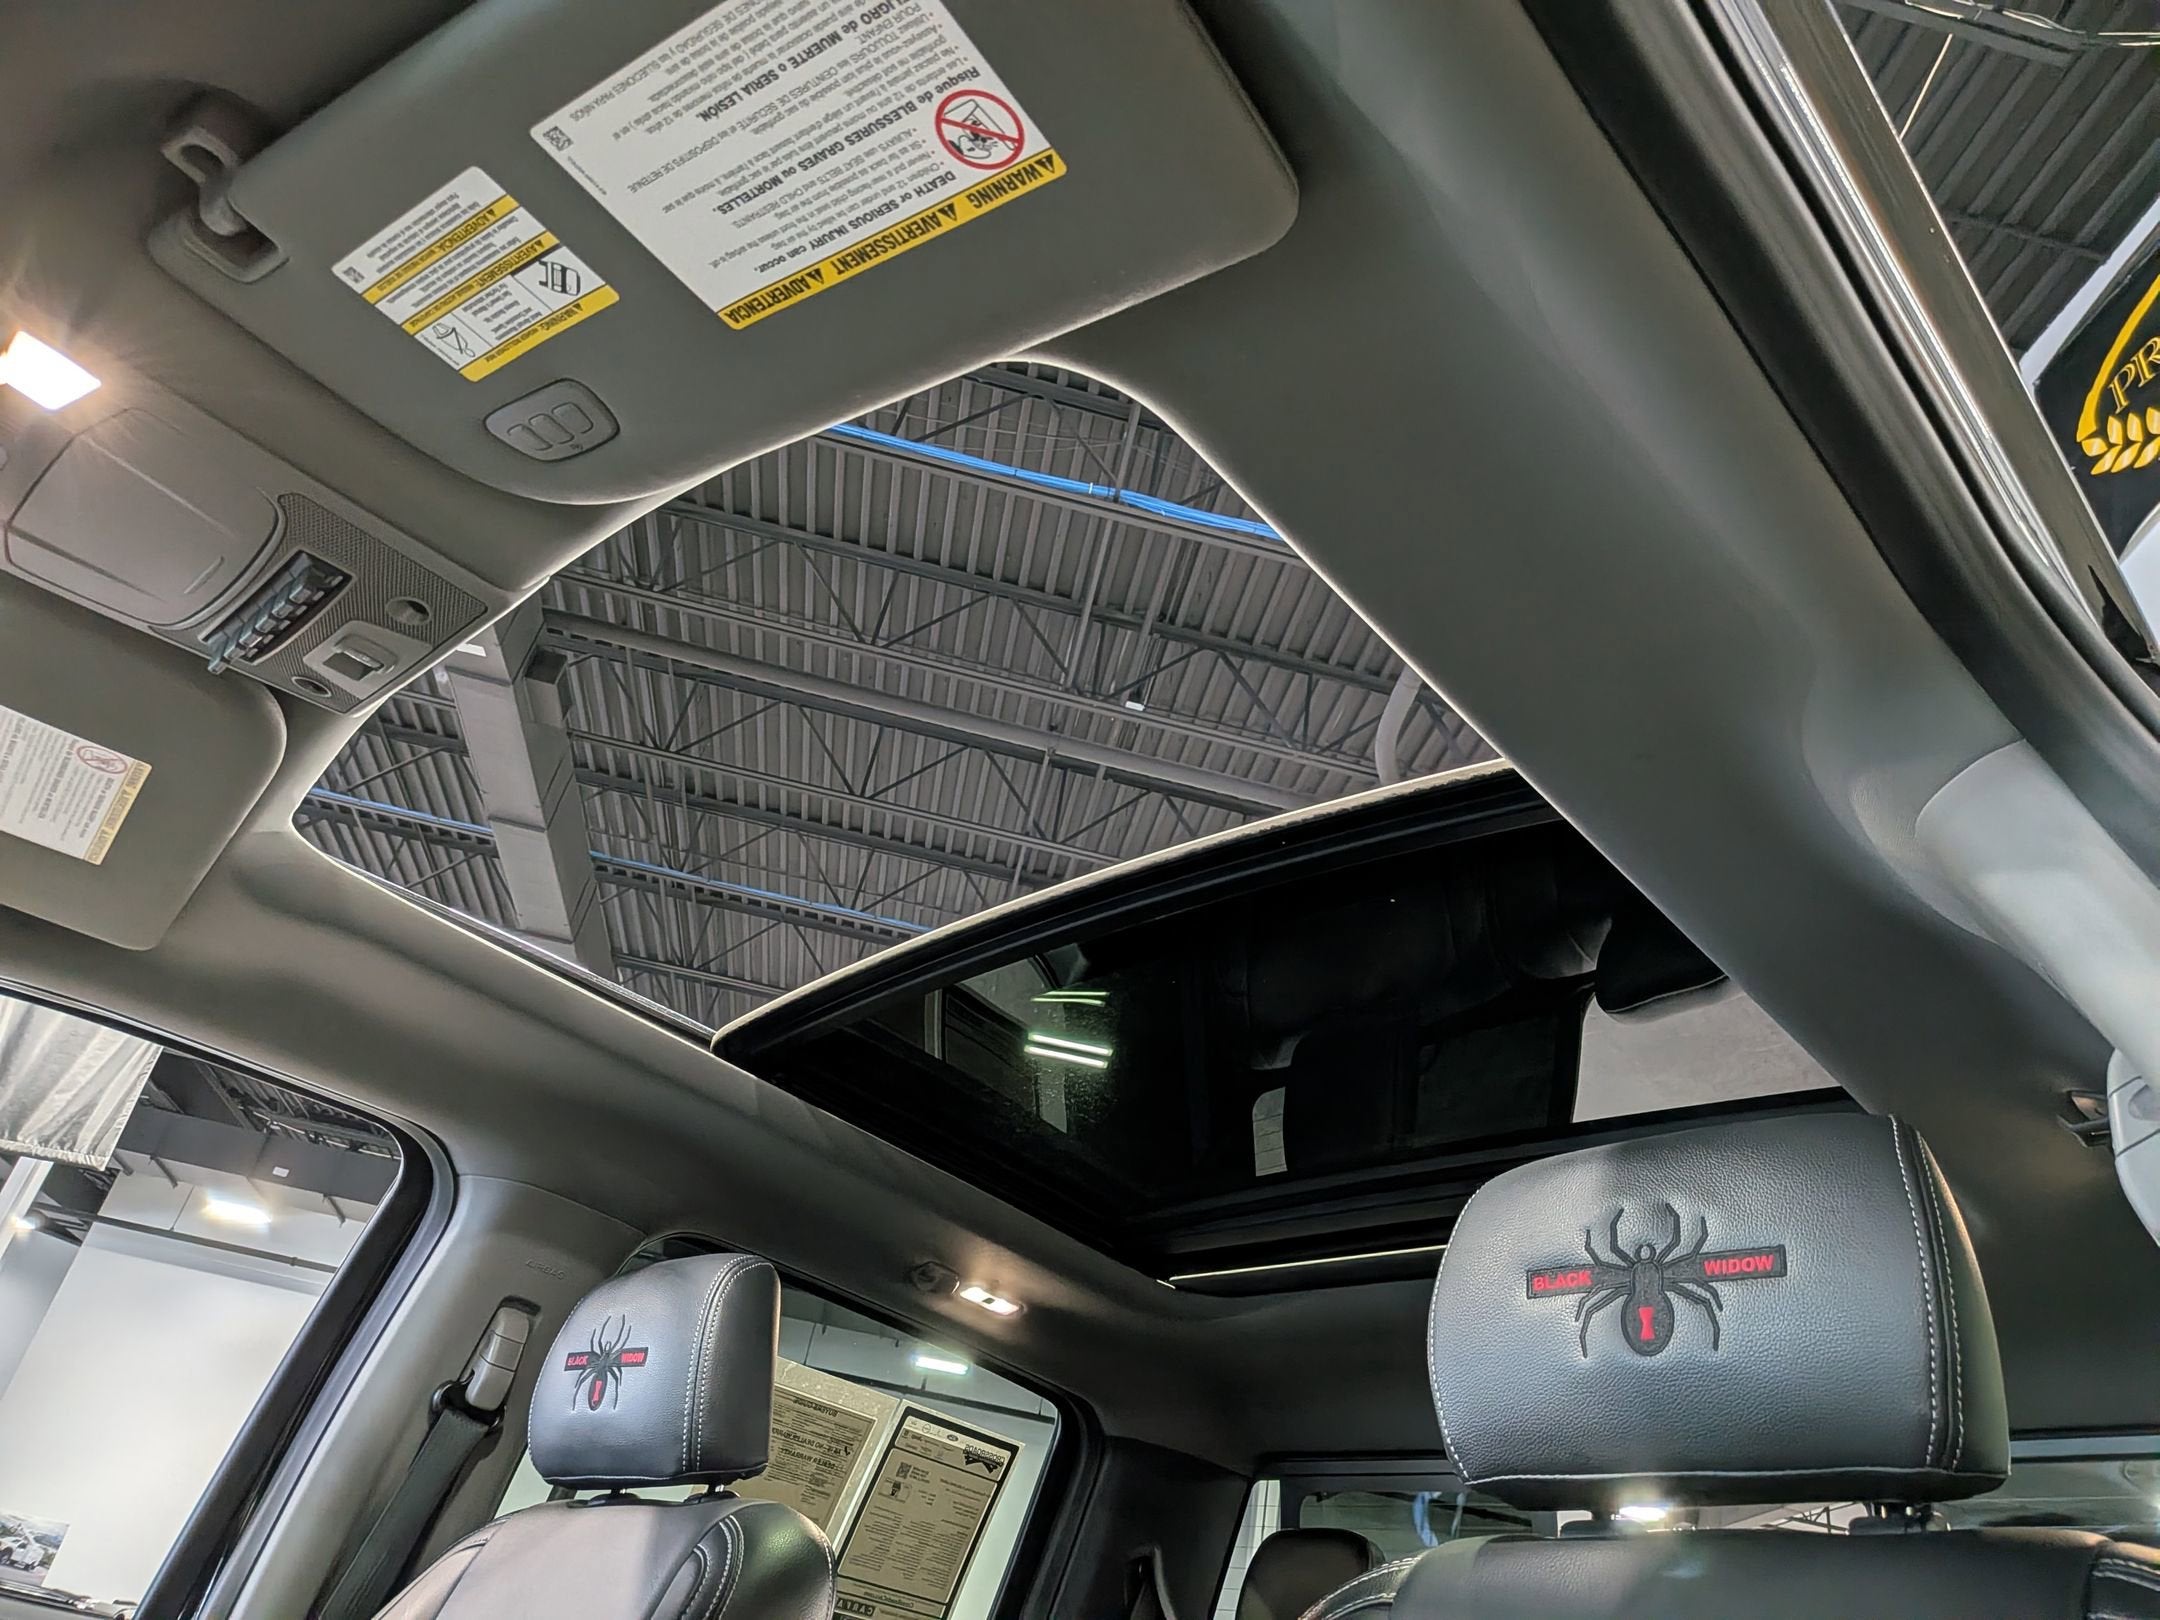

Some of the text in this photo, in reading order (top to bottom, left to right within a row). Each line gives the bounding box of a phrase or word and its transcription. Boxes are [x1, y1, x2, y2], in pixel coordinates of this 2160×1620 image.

[841, 20, 859, 34] de
[891, 2, 922, 24] POUR
[787, 30, 843, 69] MUERTE
[740, 69, 779, 96] SERIA
[777, 63, 787, 72] o
[695, 90, 744, 122] LESIÓN.
[712, 66, 981, 215] Risque de BLESSURES GRAVES ou MORTELLES.
[754, 170, 956, 273] DEATH or SERIOUS INJURY can occur.
[724, 163, 1044, 324] WARNING AVERTISSEMENT ADVERTENCIA
[1532, 1254, 1775, 1291] BLACK WIDOW
[566, 1351, 645, 1366] BLACK WIDOW
